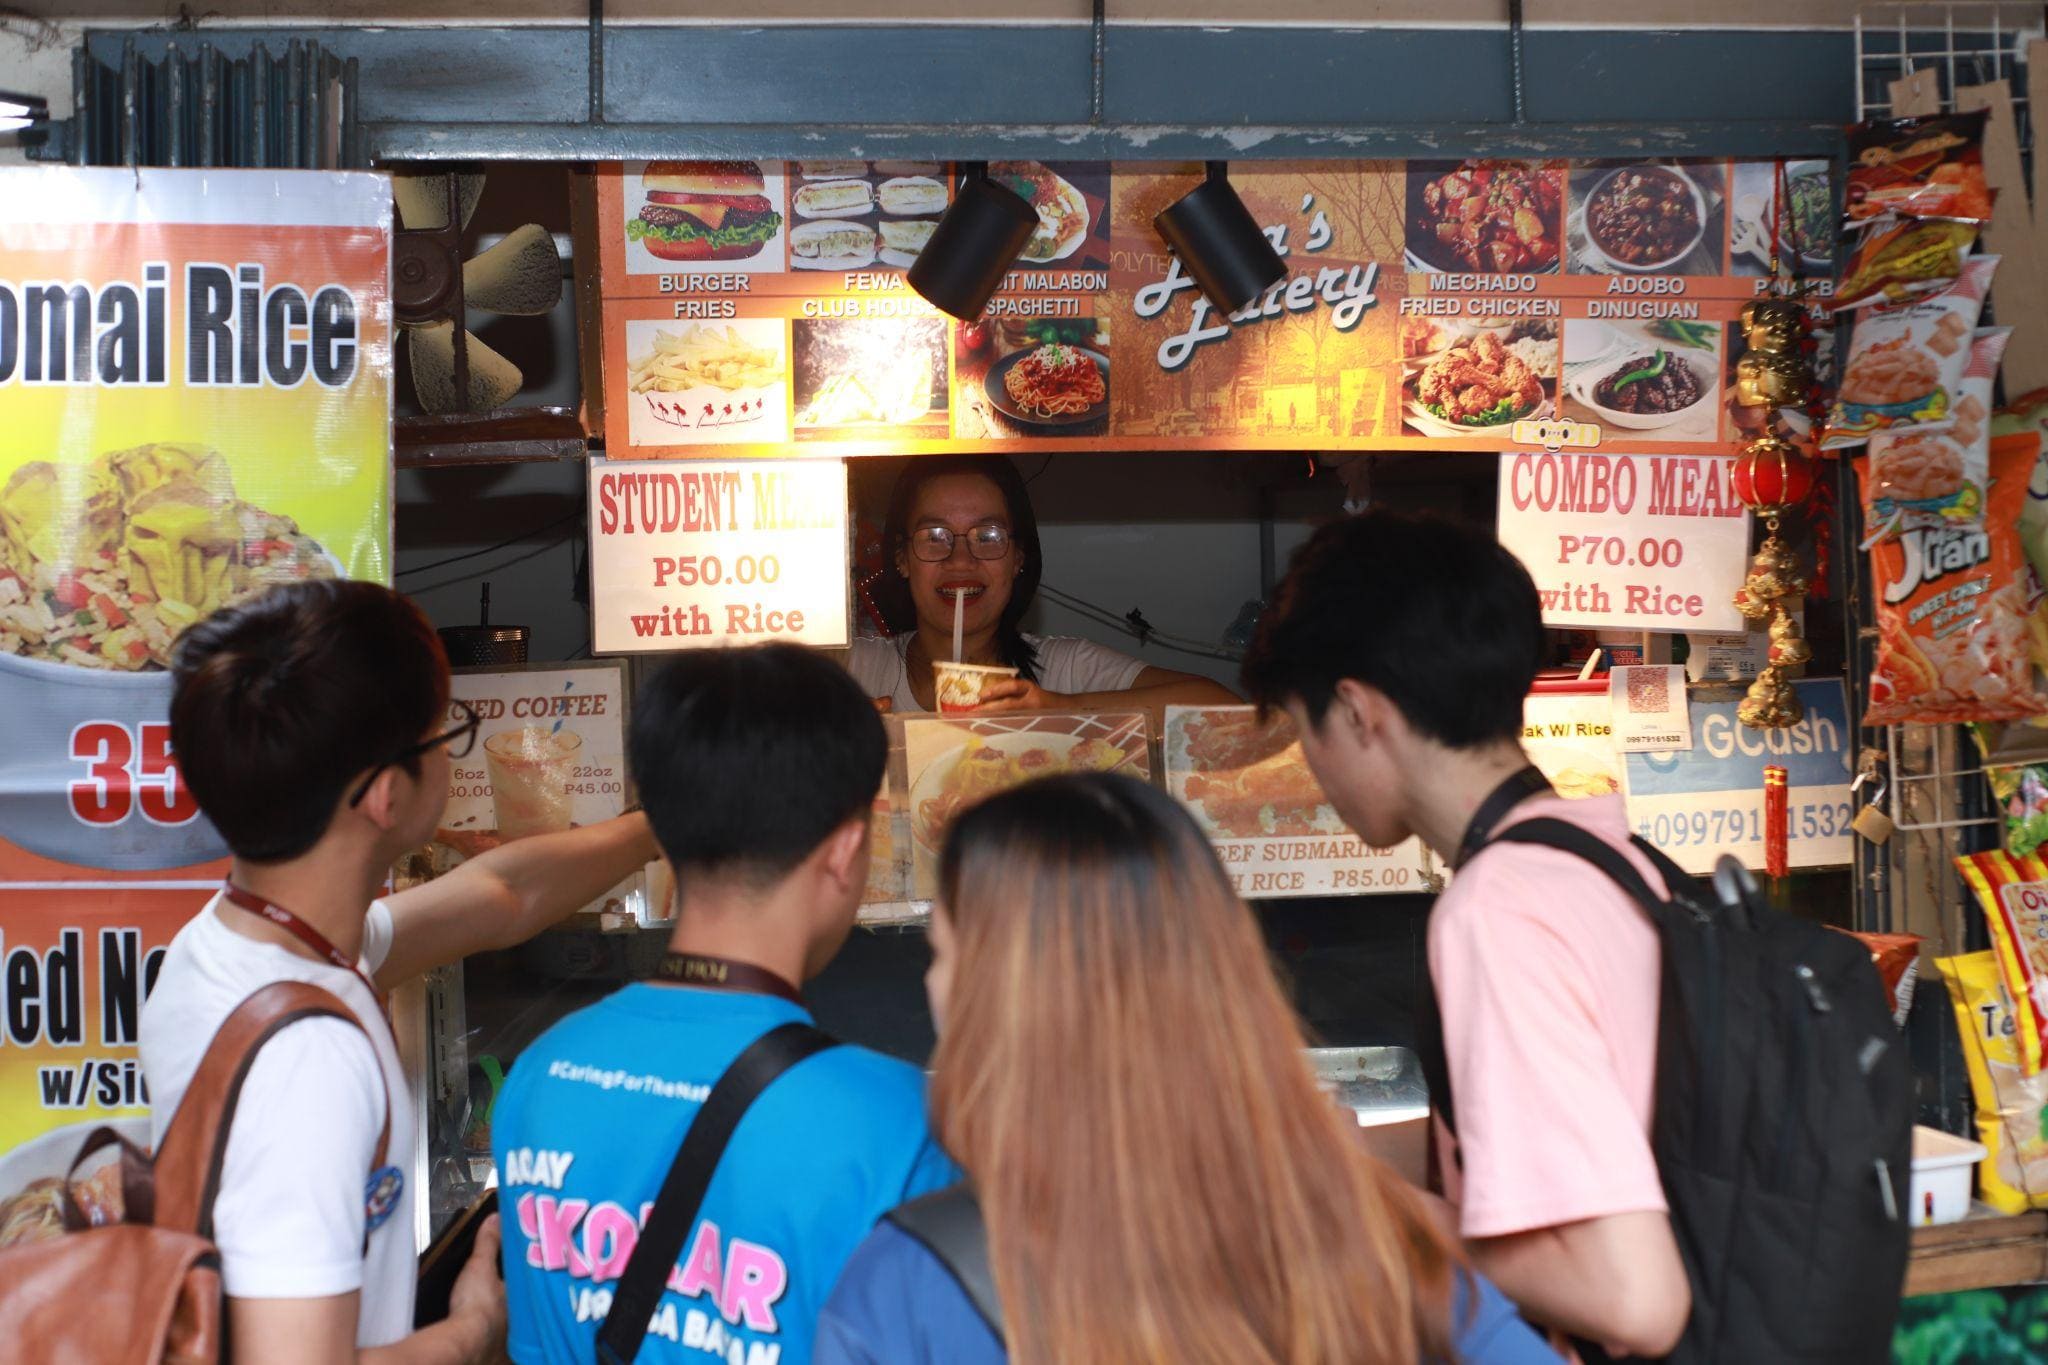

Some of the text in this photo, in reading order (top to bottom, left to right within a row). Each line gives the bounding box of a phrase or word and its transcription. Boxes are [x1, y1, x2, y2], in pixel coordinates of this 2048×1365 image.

[658, 273, 750, 292] BURGER
[844, 272, 905, 290] FEWA
[1023, 273, 1107, 291] MALABON
[1430, 273, 1537, 292] MECHADO
[1607, 277, 1685, 295] ADOBO
[673, 300, 736, 319] FRIES
[801, 298, 860, 317] CLUB
[986, 298, 1079, 316] SPAGHETTI
[1400, 298, 1561, 317] FRIED CHICKEN
[1588, 301, 1699, 319] DINUGUAN
[187, 263, 358, 388] Rice
[1511, 453, 1637, 515] COMBO
[600, 471, 742, 535] STUDENT
[1558, 535, 1683, 568] P70.00
[653, 555, 780, 587] P50.00
[1885, 531, 1990, 604] Juan
[1537, 582, 1704, 617] with Rice
[631, 603, 805, 637] with Rice
[446, 694, 608, 721] CED COFFEE
[1549, 723, 1571, 737] W/
[1576, 722, 1612, 736] Rice
[1702, 706, 1840, 760] GCash
[68, 720, 201, 827] 35
[572, 766, 613, 778] 22oz
[563, 782, 622, 796] P45.00
[1638, 802, 1852, 848] #0997911532
[1262, 840, 1395, 862] SUBMARINE
[1251, 872, 1305, 891] RICE
[1331, 868, 1409, 888] P85.00
